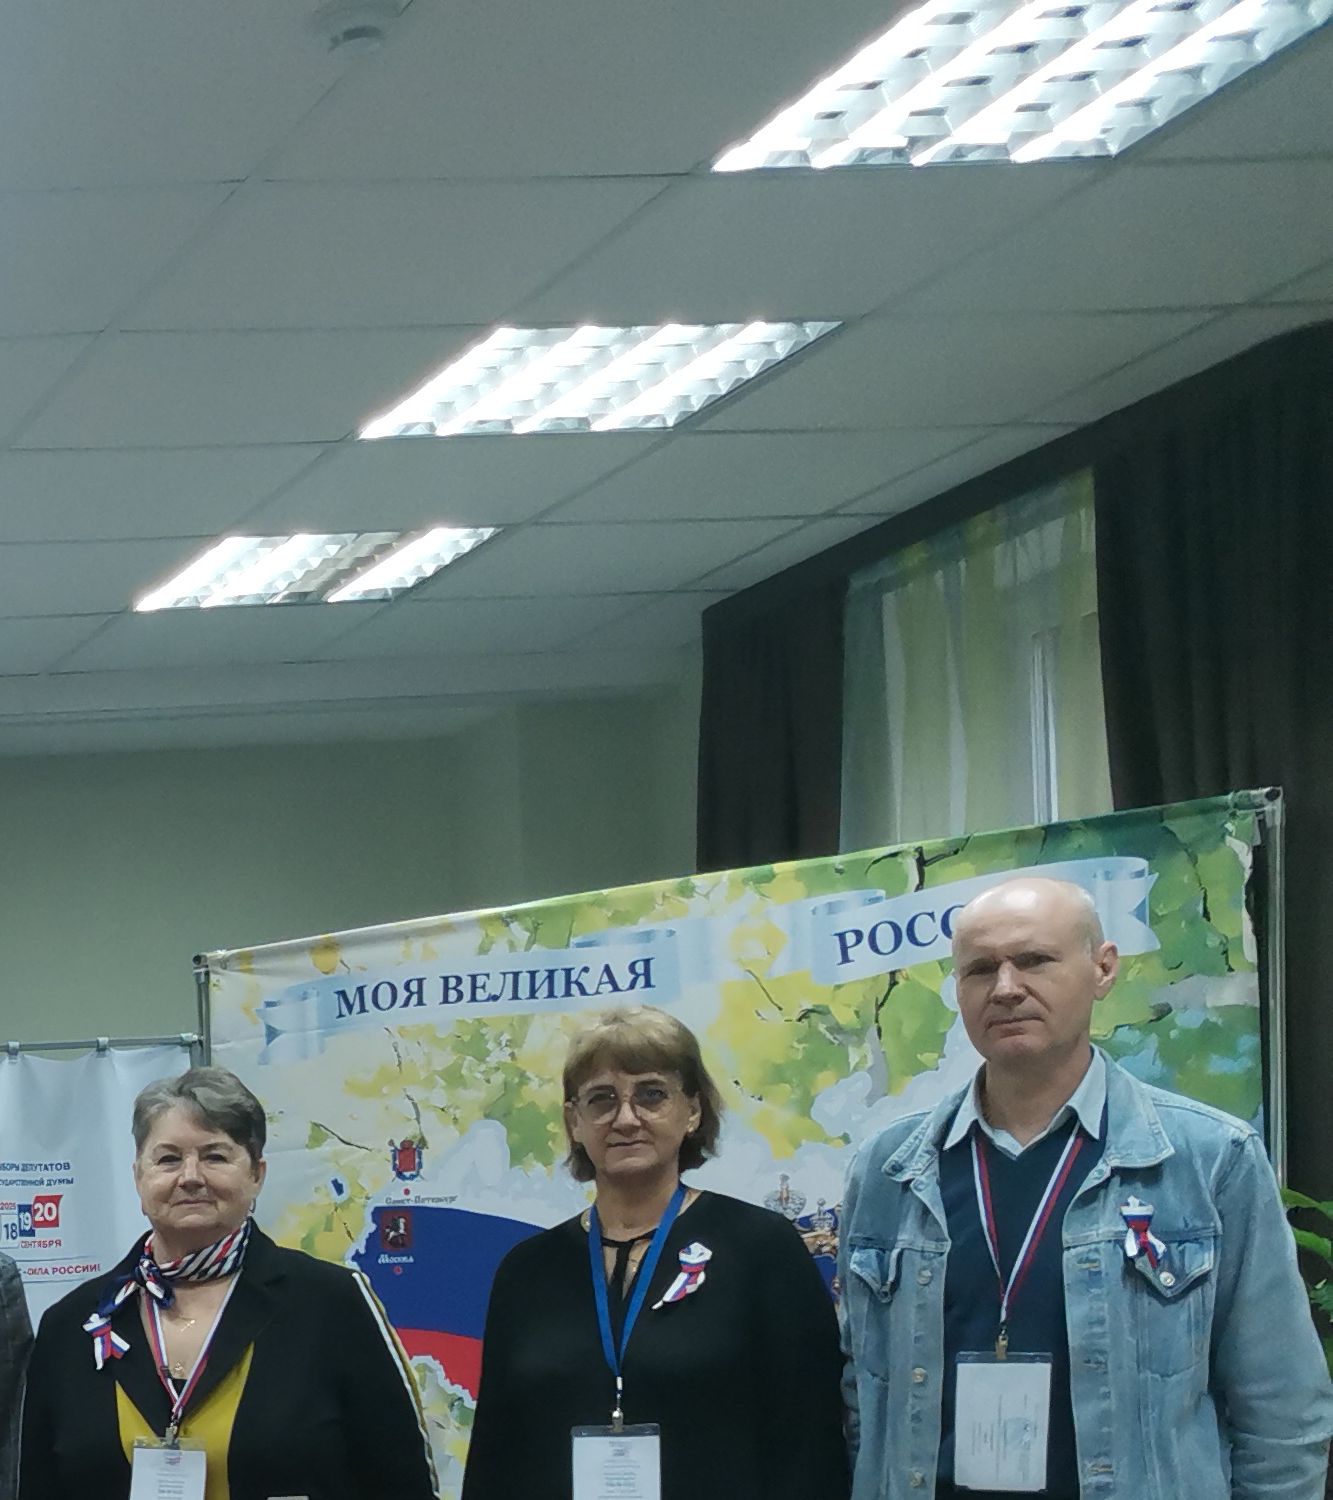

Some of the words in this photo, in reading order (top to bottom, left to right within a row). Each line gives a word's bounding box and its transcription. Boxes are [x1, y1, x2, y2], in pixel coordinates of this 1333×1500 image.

[832, 904, 965, 966] РОСС
[334, 977, 427, 1019] МОЯ
[439, 957, 655, 1005] ВЕЛИКАЯ
[21, 1162, 71, 1172] ДЕПУТАТОВ
[45, 1178, 74, 1186] ДУМЫ
[3, 1222, 18, 1240] 18
[19, 1212, 32, 1231] 19
[34, 1202, 57, 1221] 20
[52, 1263, 101, 1275] РОССИИ!
